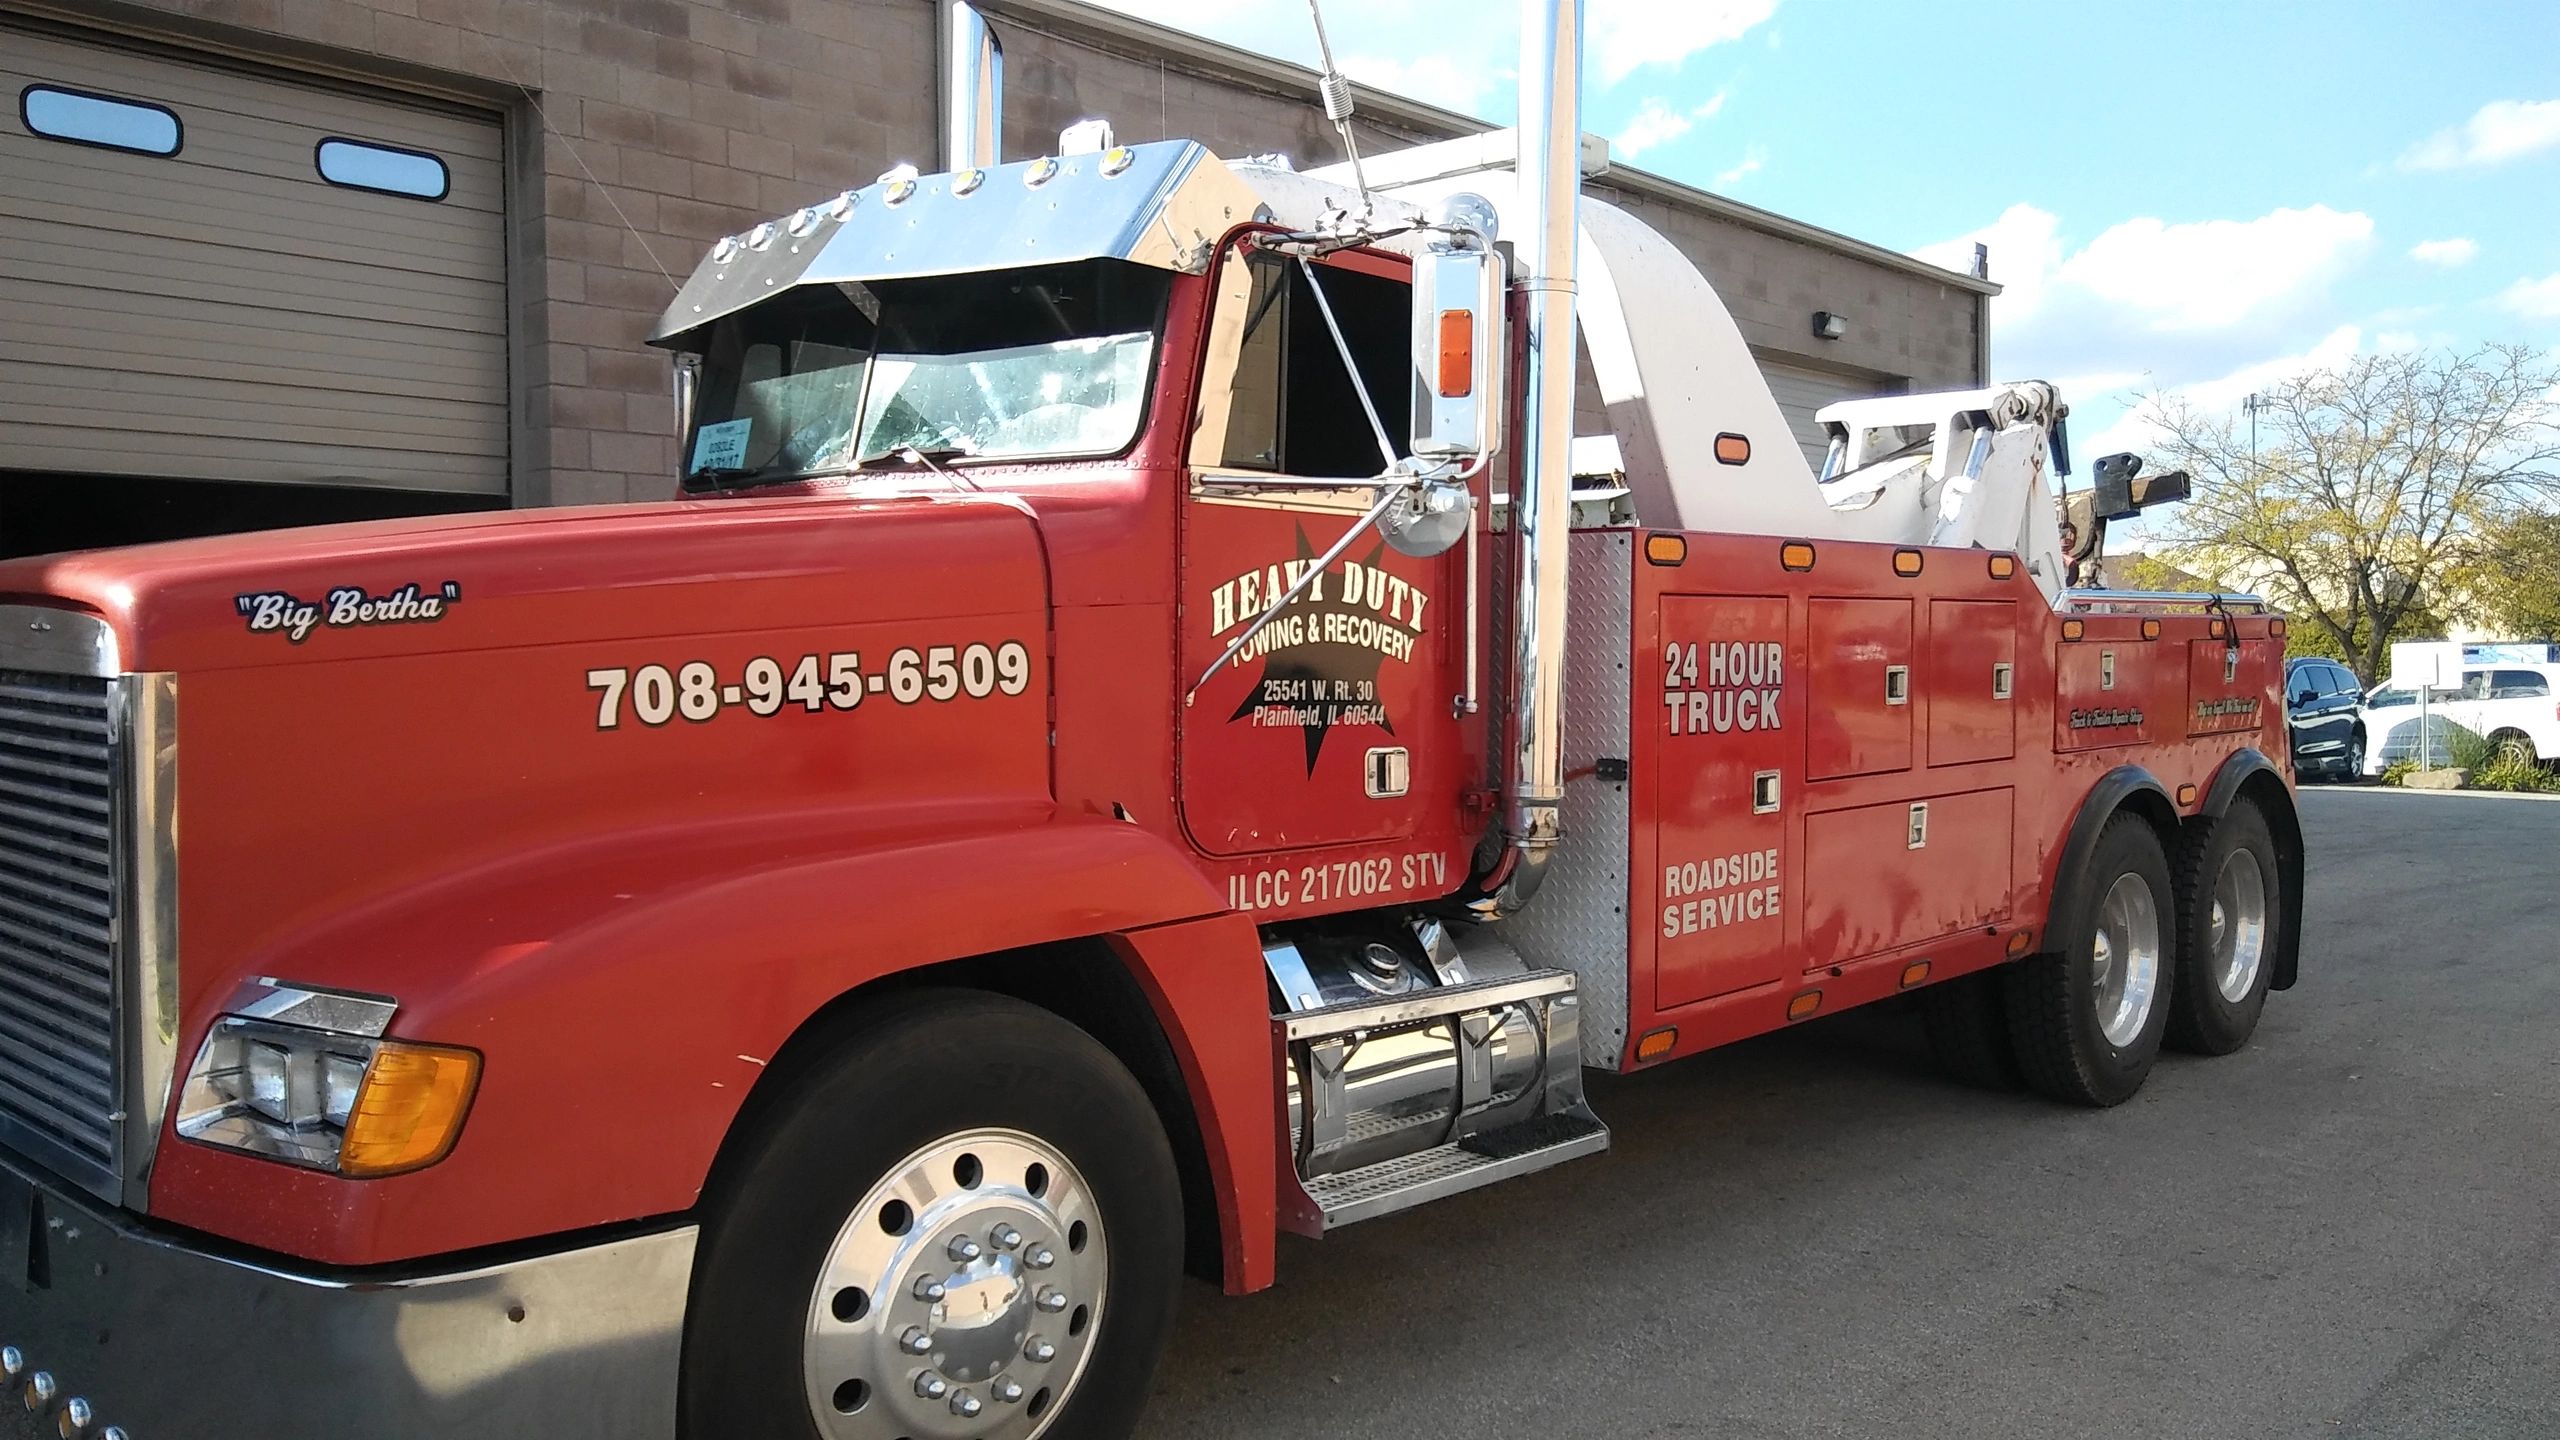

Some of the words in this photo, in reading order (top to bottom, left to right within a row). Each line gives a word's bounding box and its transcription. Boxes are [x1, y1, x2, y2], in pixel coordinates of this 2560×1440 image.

[238, 594, 318, 641] "Big
[328, 584, 458, 625] Bertha"
[1211, 558, 1325, 638] HEAVY
[1341, 560, 1429, 633] DUTY
[1226, 613, 1303, 668] TOWING
[1307, 613, 1320, 643] &
[1325, 613, 1415, 664] RECOVERY
[1664, 641, 1698, 687] 24
[1709, 641, 1783, 687] HOUR
[587, 641, 1030, 728] 708-945-6509
[1263, 679, 1307, 702] 25541
[1312, 679, 1330, 701] W.
[1334, 680, 1353, 701] Rt.
[1356, 680, 1374, 701] 30
[1252, 704, 1323, 729] Plainfield,
[1327, 704, 1340, 726] IL
[1343, 704, 1385, 726] 60544
[1664, 689, 1782, 734] TRUCK
[1229, 868, 1291, 912] ILCC
[1301, 857, 1392, 904] 217062
[1402, 852, 1447, 890] STV
[1665, 848, 1778, 898] ROADSIDE
[1663, 885, 1780, 938] SERVICE
